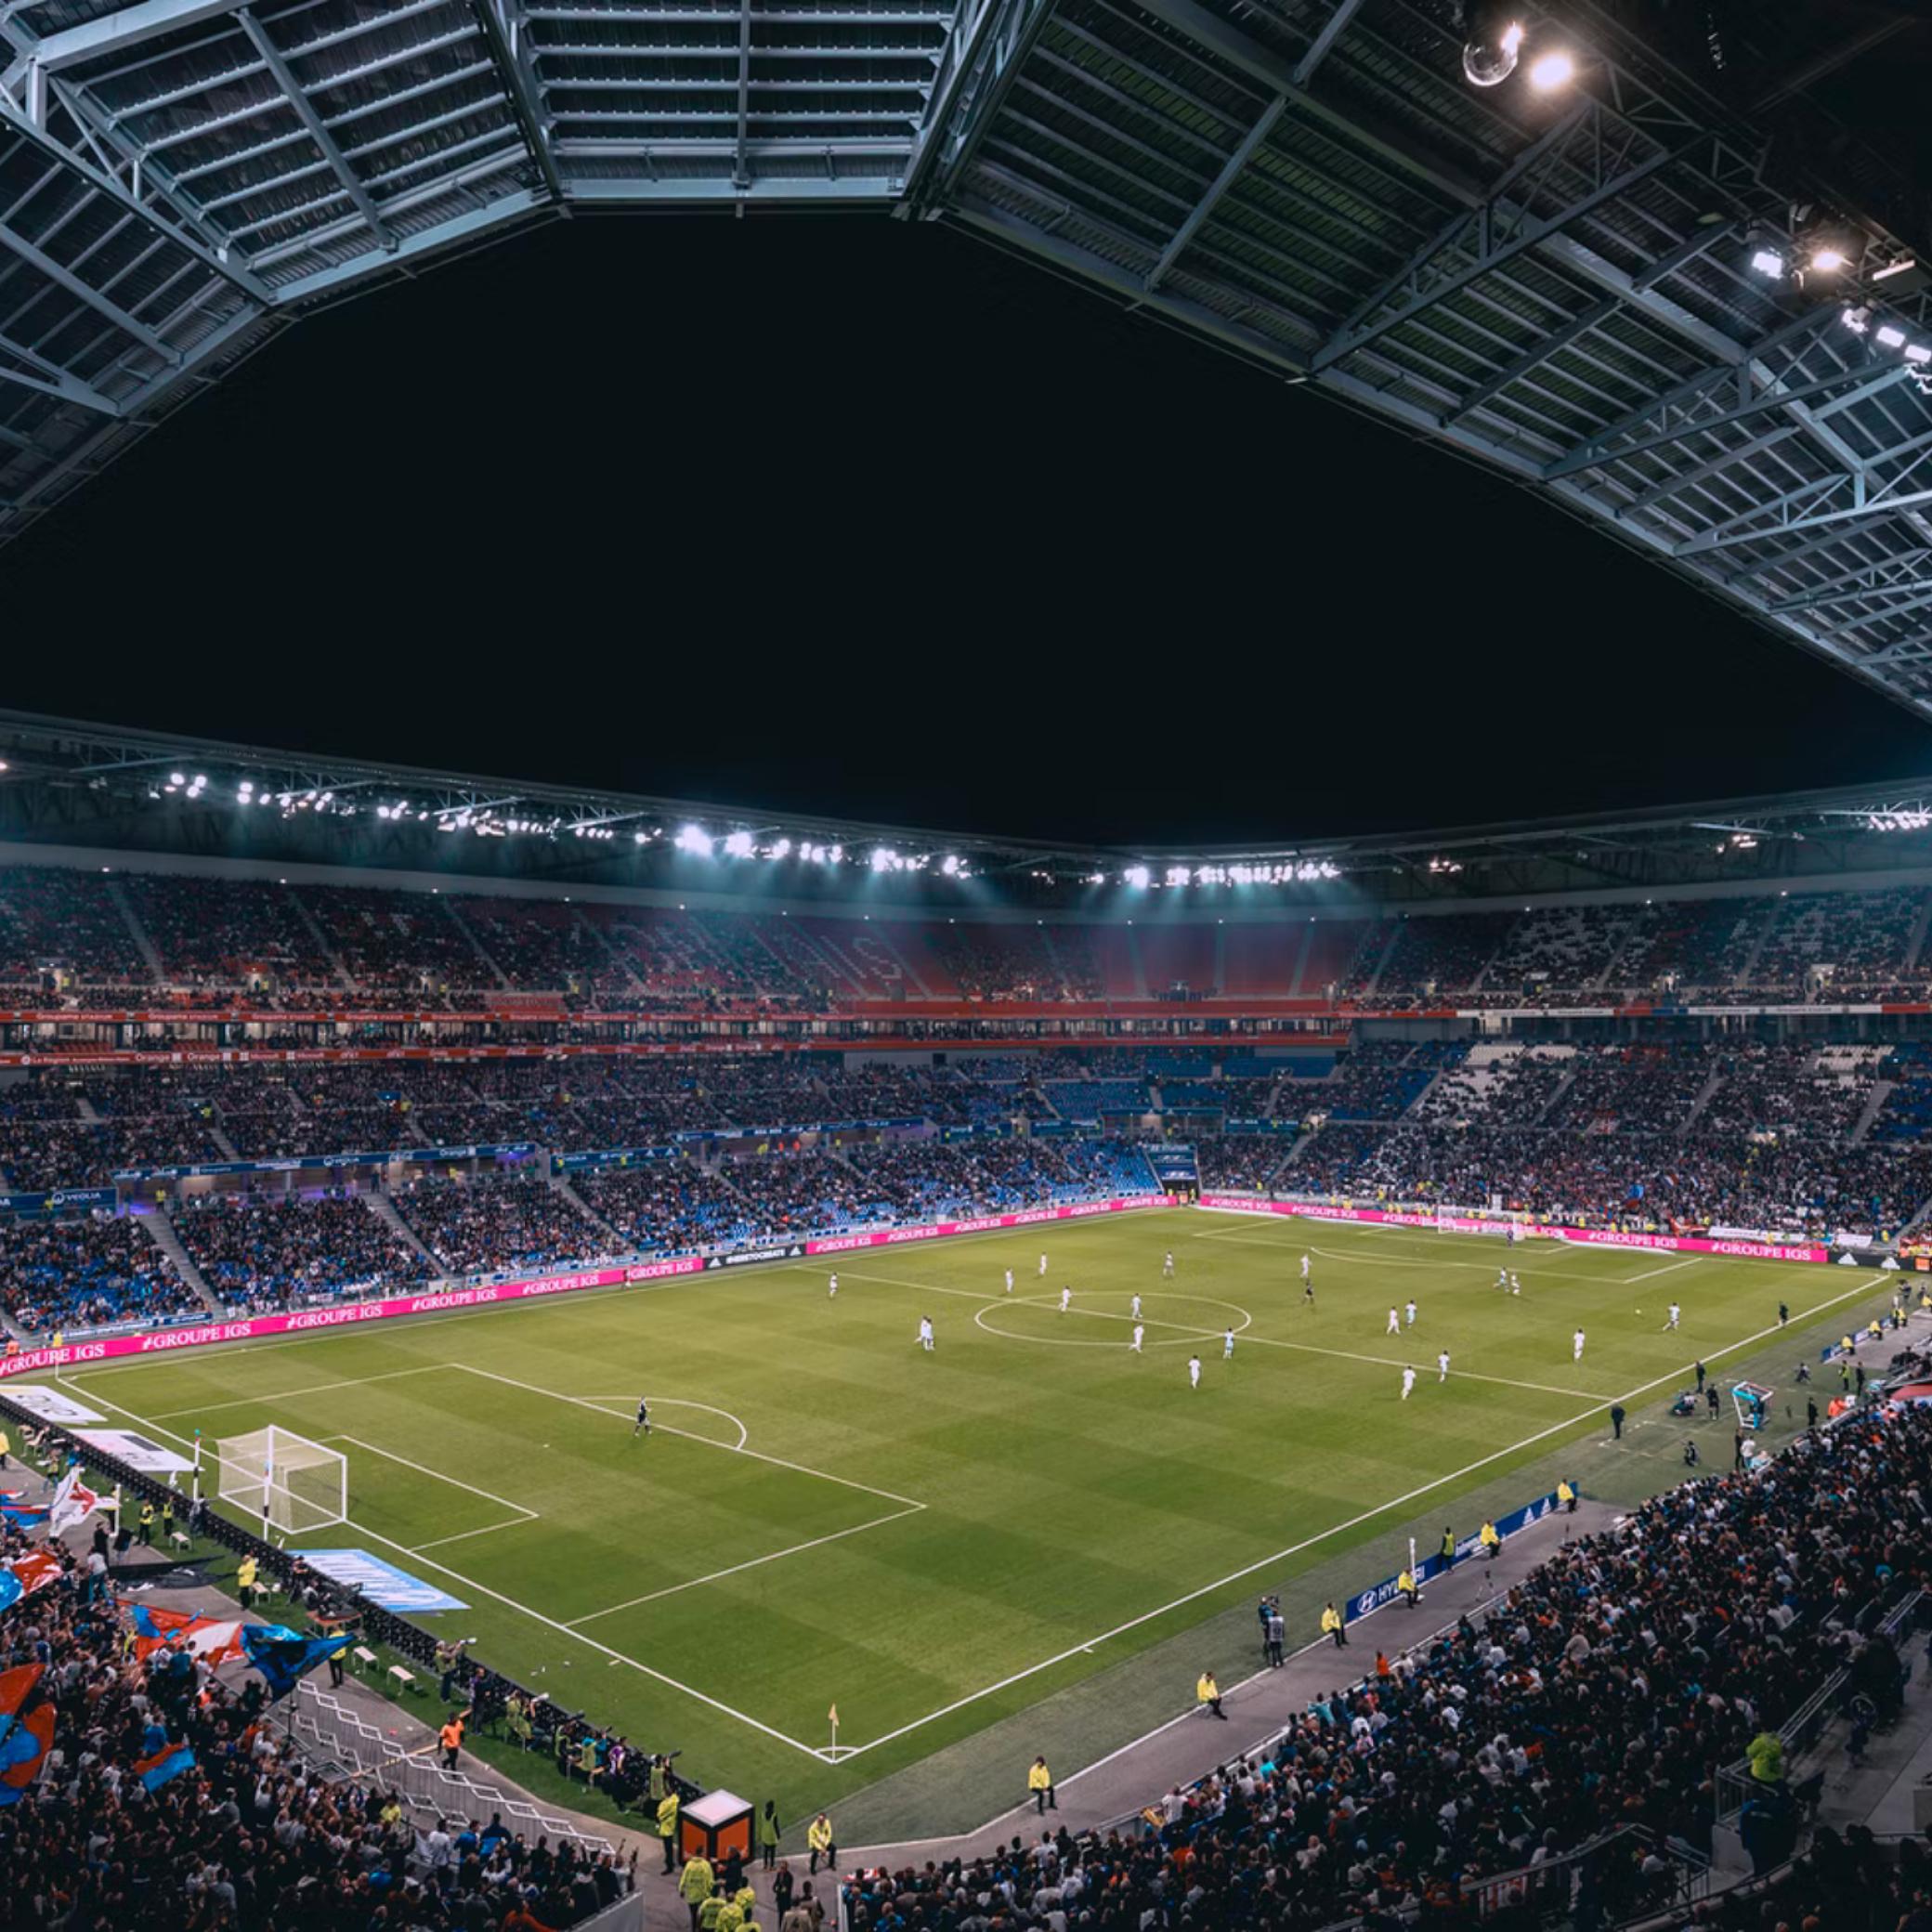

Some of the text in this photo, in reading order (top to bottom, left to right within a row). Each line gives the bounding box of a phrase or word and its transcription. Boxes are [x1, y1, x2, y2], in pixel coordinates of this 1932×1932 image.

[1588, 1232, 1677, 1247] #GROUPE IGS
[1712, 1243, 1811, 1260] #GROUPE IGS
[626, 1260, 694, 1279] GROUPE IGS
[523, 1274, 599, 1294] #GROUPE IGS
[412, 1288, 498, 1310] #GROUPE IGS
[287, 1304, 383, 1328] #GROUPE IGS
[143, 1326, 220, 1350] #GROUPE
[225, 1323, 252, 1338] IGS
[76, 1343, 106, 1361] IGS
